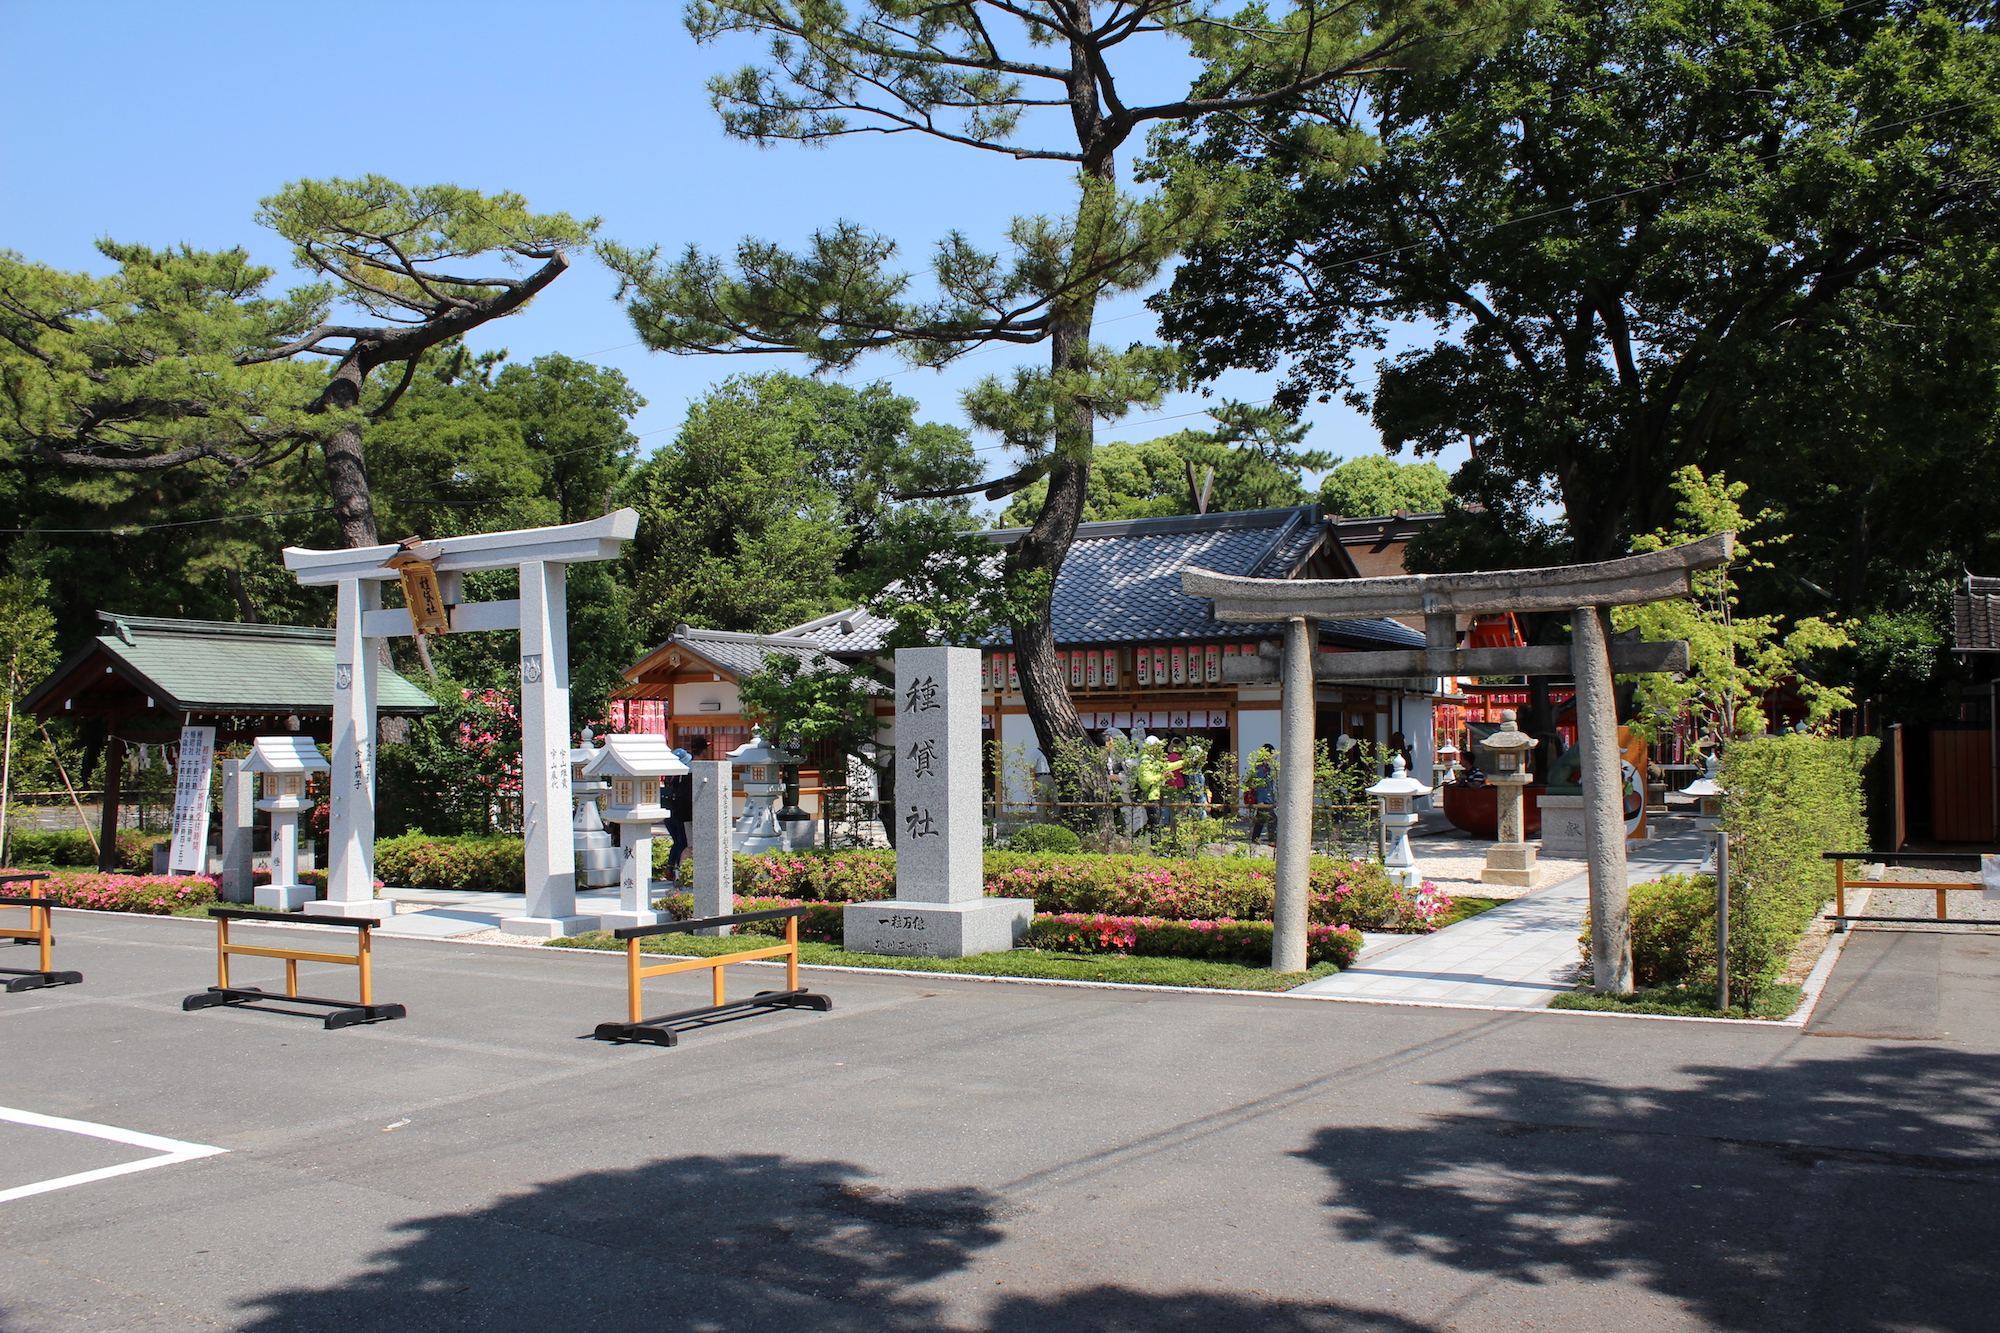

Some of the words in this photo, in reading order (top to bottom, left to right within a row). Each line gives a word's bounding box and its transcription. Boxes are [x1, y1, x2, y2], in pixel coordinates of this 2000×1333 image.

[903, 675, 941, 840] 種貸社
[878, 914, 926, 931] 一粒万倍
